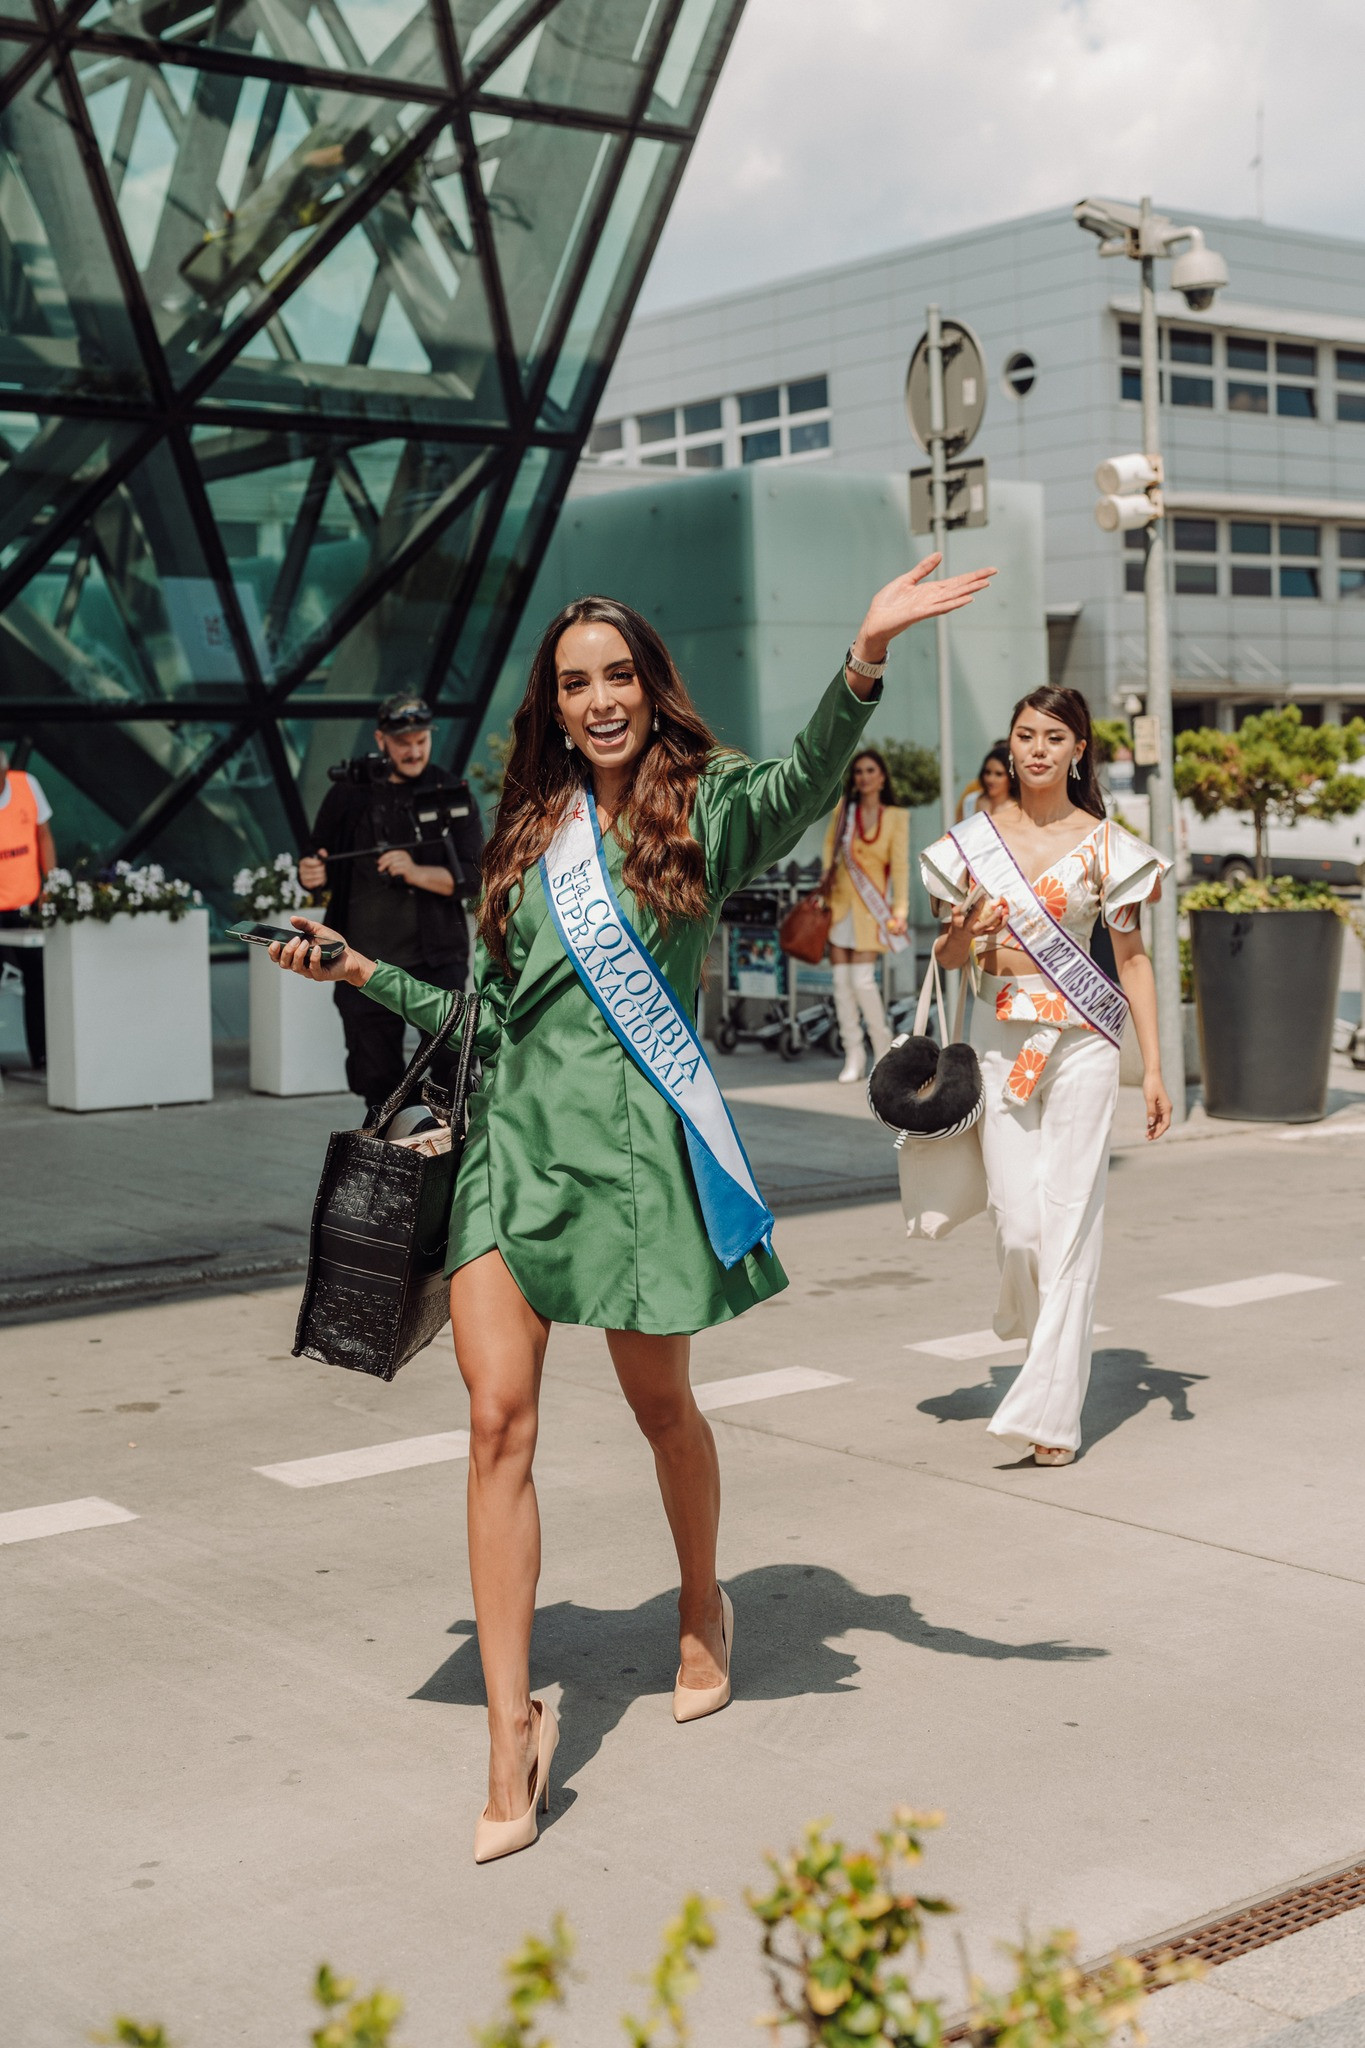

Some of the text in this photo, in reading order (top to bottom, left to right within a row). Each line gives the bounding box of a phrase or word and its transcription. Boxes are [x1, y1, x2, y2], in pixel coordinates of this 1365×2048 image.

[552, 871, 690, 1097] SUPRANACIONAL
[572, 859, 701, 1084] Srta. COLOMBIA
[1037, 937, 1076, 973] 2022
[1058, 959, 1097, 998] MISS
